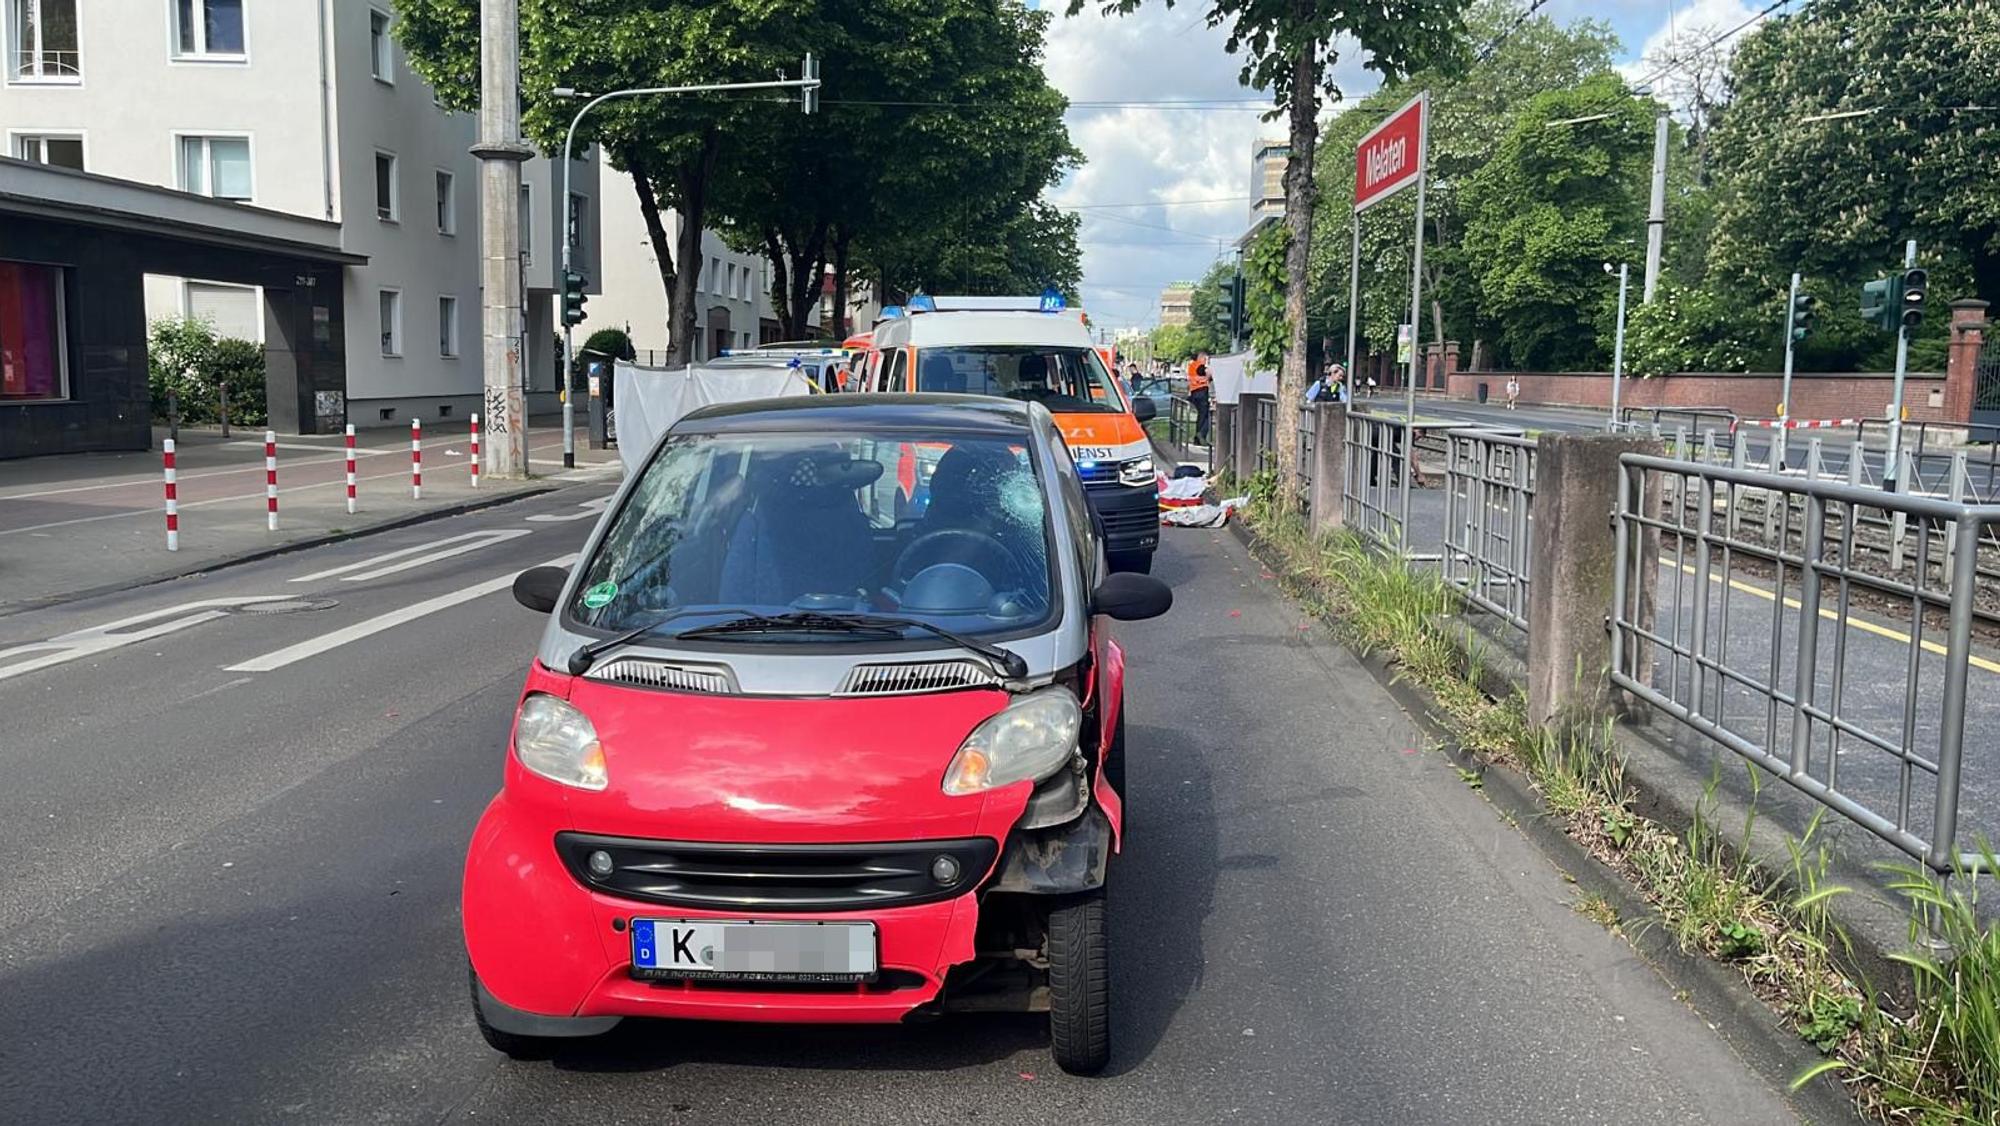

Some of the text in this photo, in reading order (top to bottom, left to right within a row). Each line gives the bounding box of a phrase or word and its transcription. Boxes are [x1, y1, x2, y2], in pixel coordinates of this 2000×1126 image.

[1365, 136, 1406, 190] Melaten
[641, 948, 650, 959] D
[673, 928, 696, 964] K
[671, 970, 740, 979] AUTOZENTRUM
